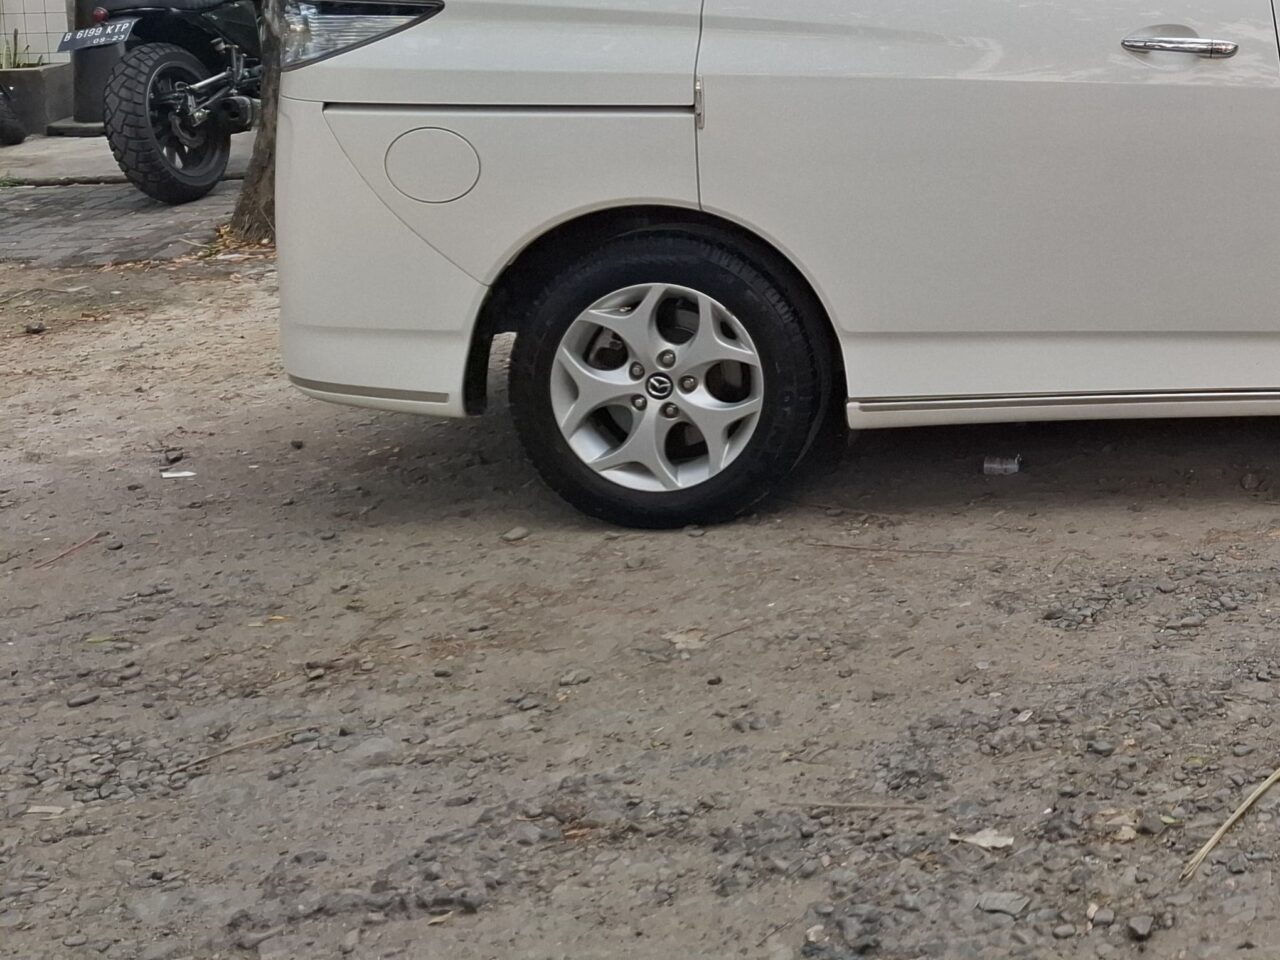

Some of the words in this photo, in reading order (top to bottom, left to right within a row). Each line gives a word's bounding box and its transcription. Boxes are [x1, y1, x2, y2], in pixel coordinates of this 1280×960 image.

[64, 32, 73, 42] B
[75, 27, 103, 40] 6199
[105, 22, 130, 34] KTP
